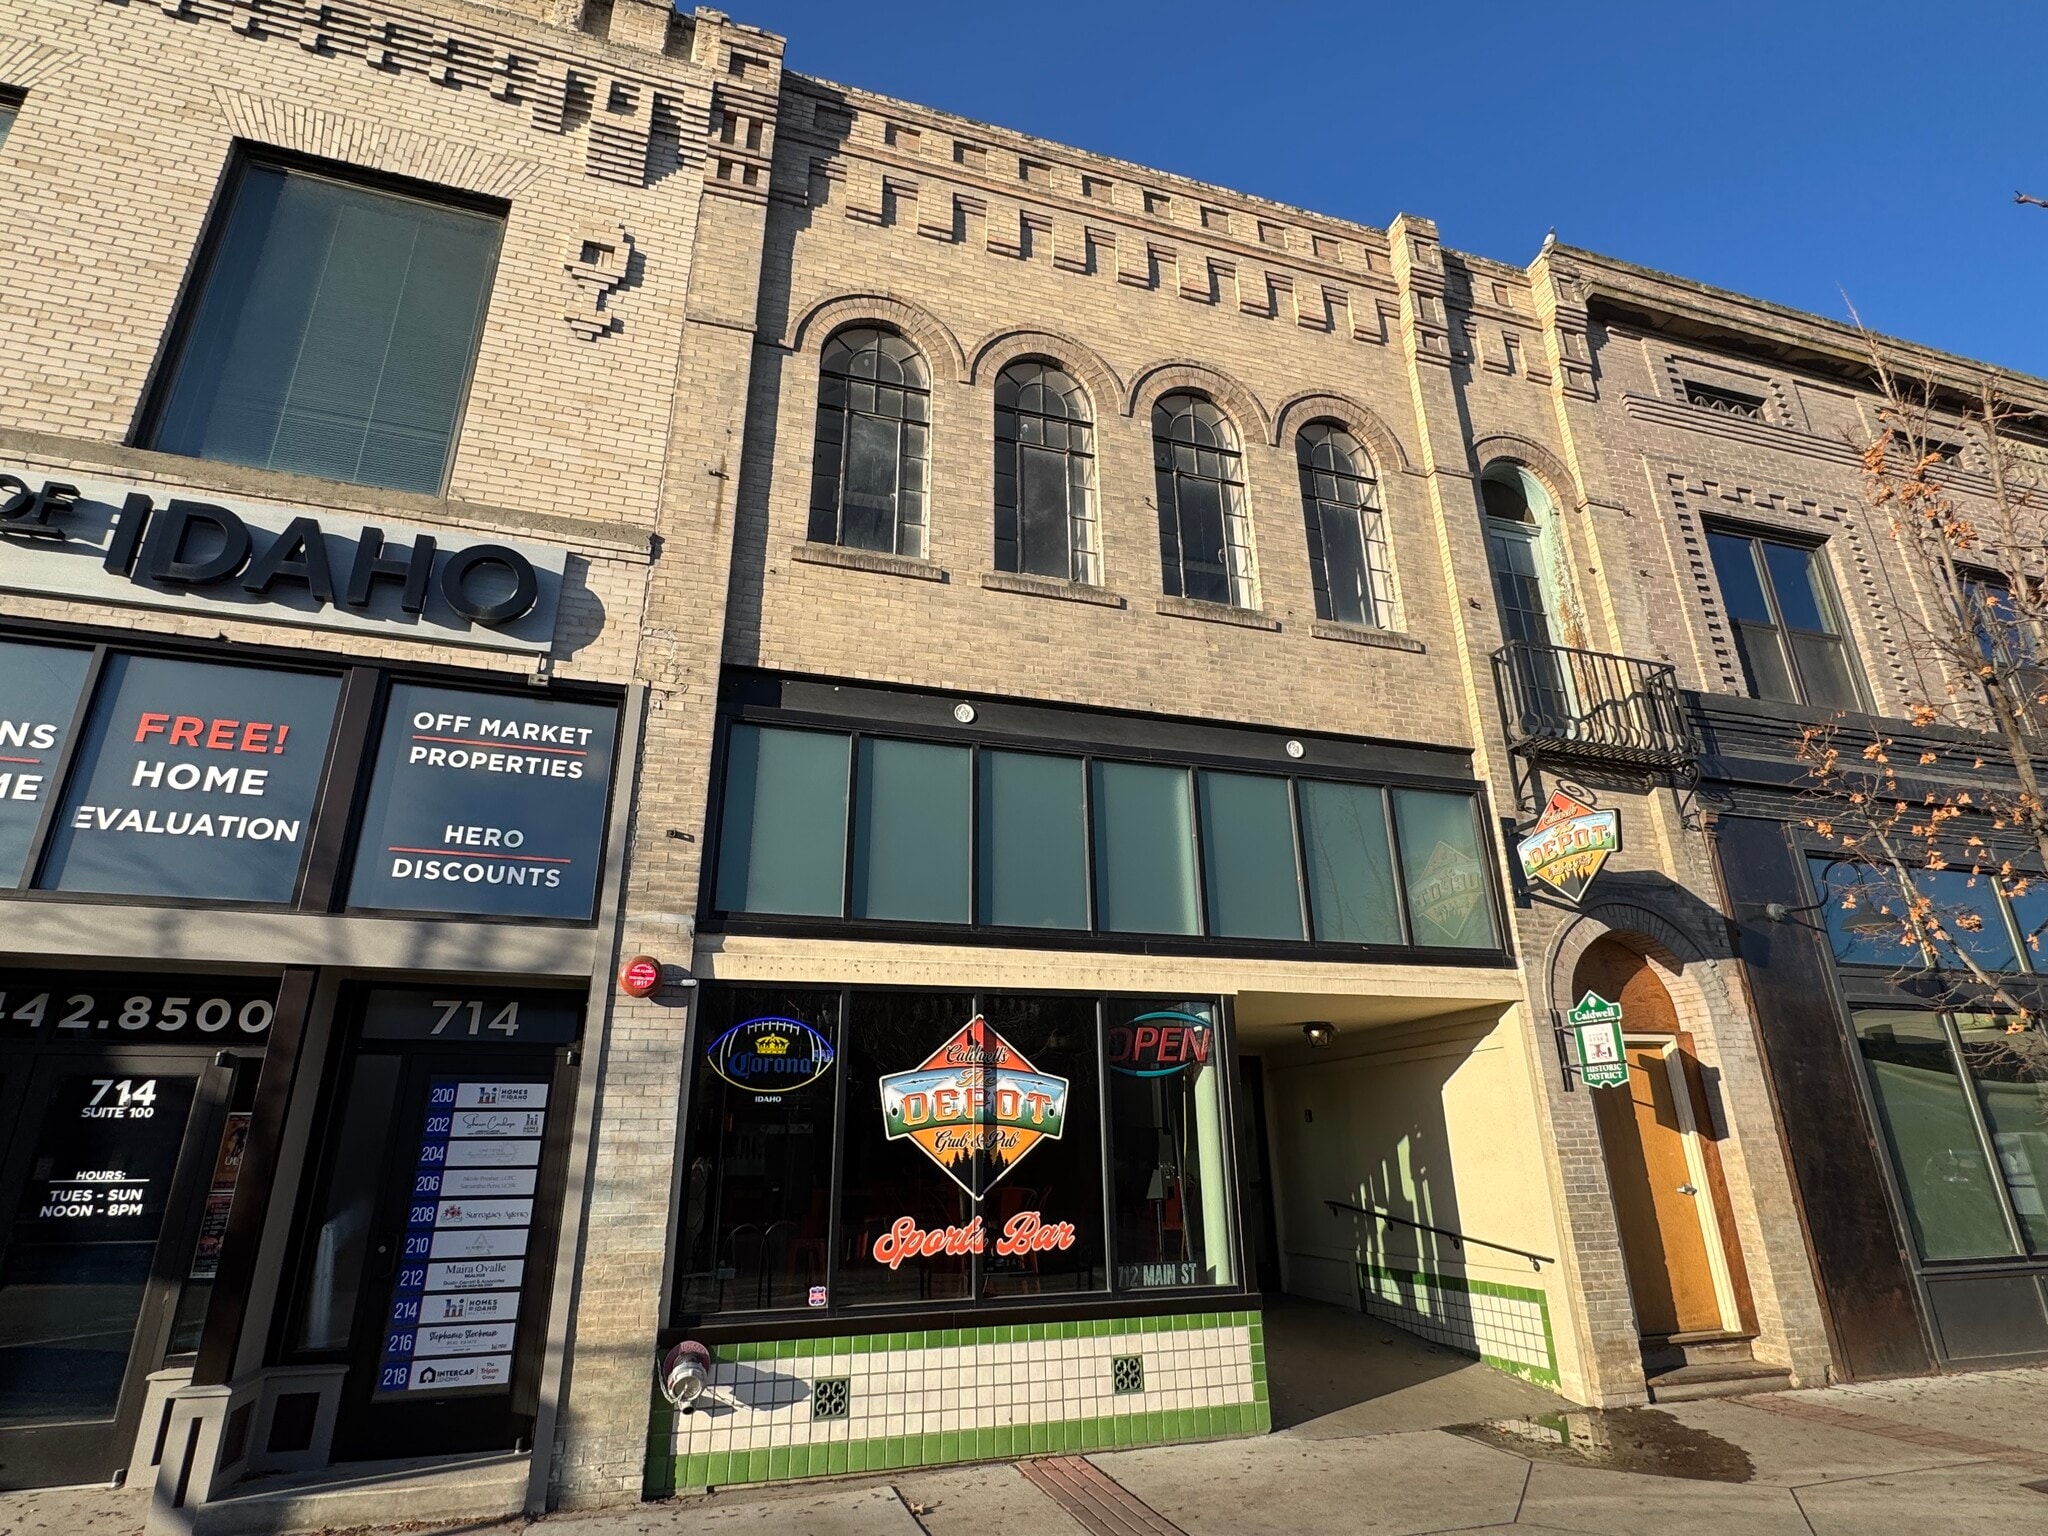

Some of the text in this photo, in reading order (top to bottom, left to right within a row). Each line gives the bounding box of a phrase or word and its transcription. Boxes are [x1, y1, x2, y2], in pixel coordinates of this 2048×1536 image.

[103, 492, 538, 627] IDAHO
[135, 712, 290, 754] FREE!
[413, 712, 593, 746] OFF MARKET
[409, 746, 584, 779] PROPERTIES
[131, 760, 269, 796] HOME
[71, 806, 301, 842] EVALUATION
[444, 825, 524, 848] HERO
[1528, 824, 1607, 869] DEPOT
[391, 858, 561, 888] DISCOUNTS
[0, 992, 273, 1033] 42.8500
[430, 1000, 519, 1036] 714
[1574, 1007, 1615, 1021] Caldwell
[1108, 1026, 1212, 1062] OPEN
[728, 1051, 812, 1079] Corona
[1586, 1063, 1622, 1073] HISTORIC
[956, 1068, 997, 1087] The
[1587, 1071, 1622, 1081] DISTRICT
[89, 1079, 157, 1106] 714
[431, 1088, 455, 1103] 200
[478, 1087, 497, 1104] hi
[754, 1095, 782, 1103] IDAHO
[81, 1107, 155, 1118] SUITE 100
[901, 1088, 1053, 1126] DEPOT
[426, 1117, 450, 1132] 202
[525, 1114, 539, 1126] hi
[934, 1130, 1020, 1154] Grub & Pub
[421, 1146, 445, 1161] 204
[76, 1171, 127, 1180] HOURS:
[416, 1176, 440, 1191] 206
[50, 1189, 93, 1202] TUES
[107, 1189, 143, 1201] SUN
[40, 1204, 94, 1217] NOON
[107, 1204, 144, 1216] 8PM
[410, 1207, 435, 1222] 208
[466, 1208, 530, 1221] Surrogacy Agency
[405, 1238, 429, 1254] 210
[873, 1211, 1075, 1270] Sports Bar
[445, 1262, 507, 1275] Maira Ovalle
[1118, 1262, 1197, 1288] 712 MAIN ST
[400, 1270, 424, 1287] 212
[394, 1302, 418, 1319] 214
[443, 1299, 464, 1319] hi
[388, 1334, 413, 1352] 216
[382, 1367, 407, 1386] 218
[437, 1368, 474, 1377] INTERCAP
